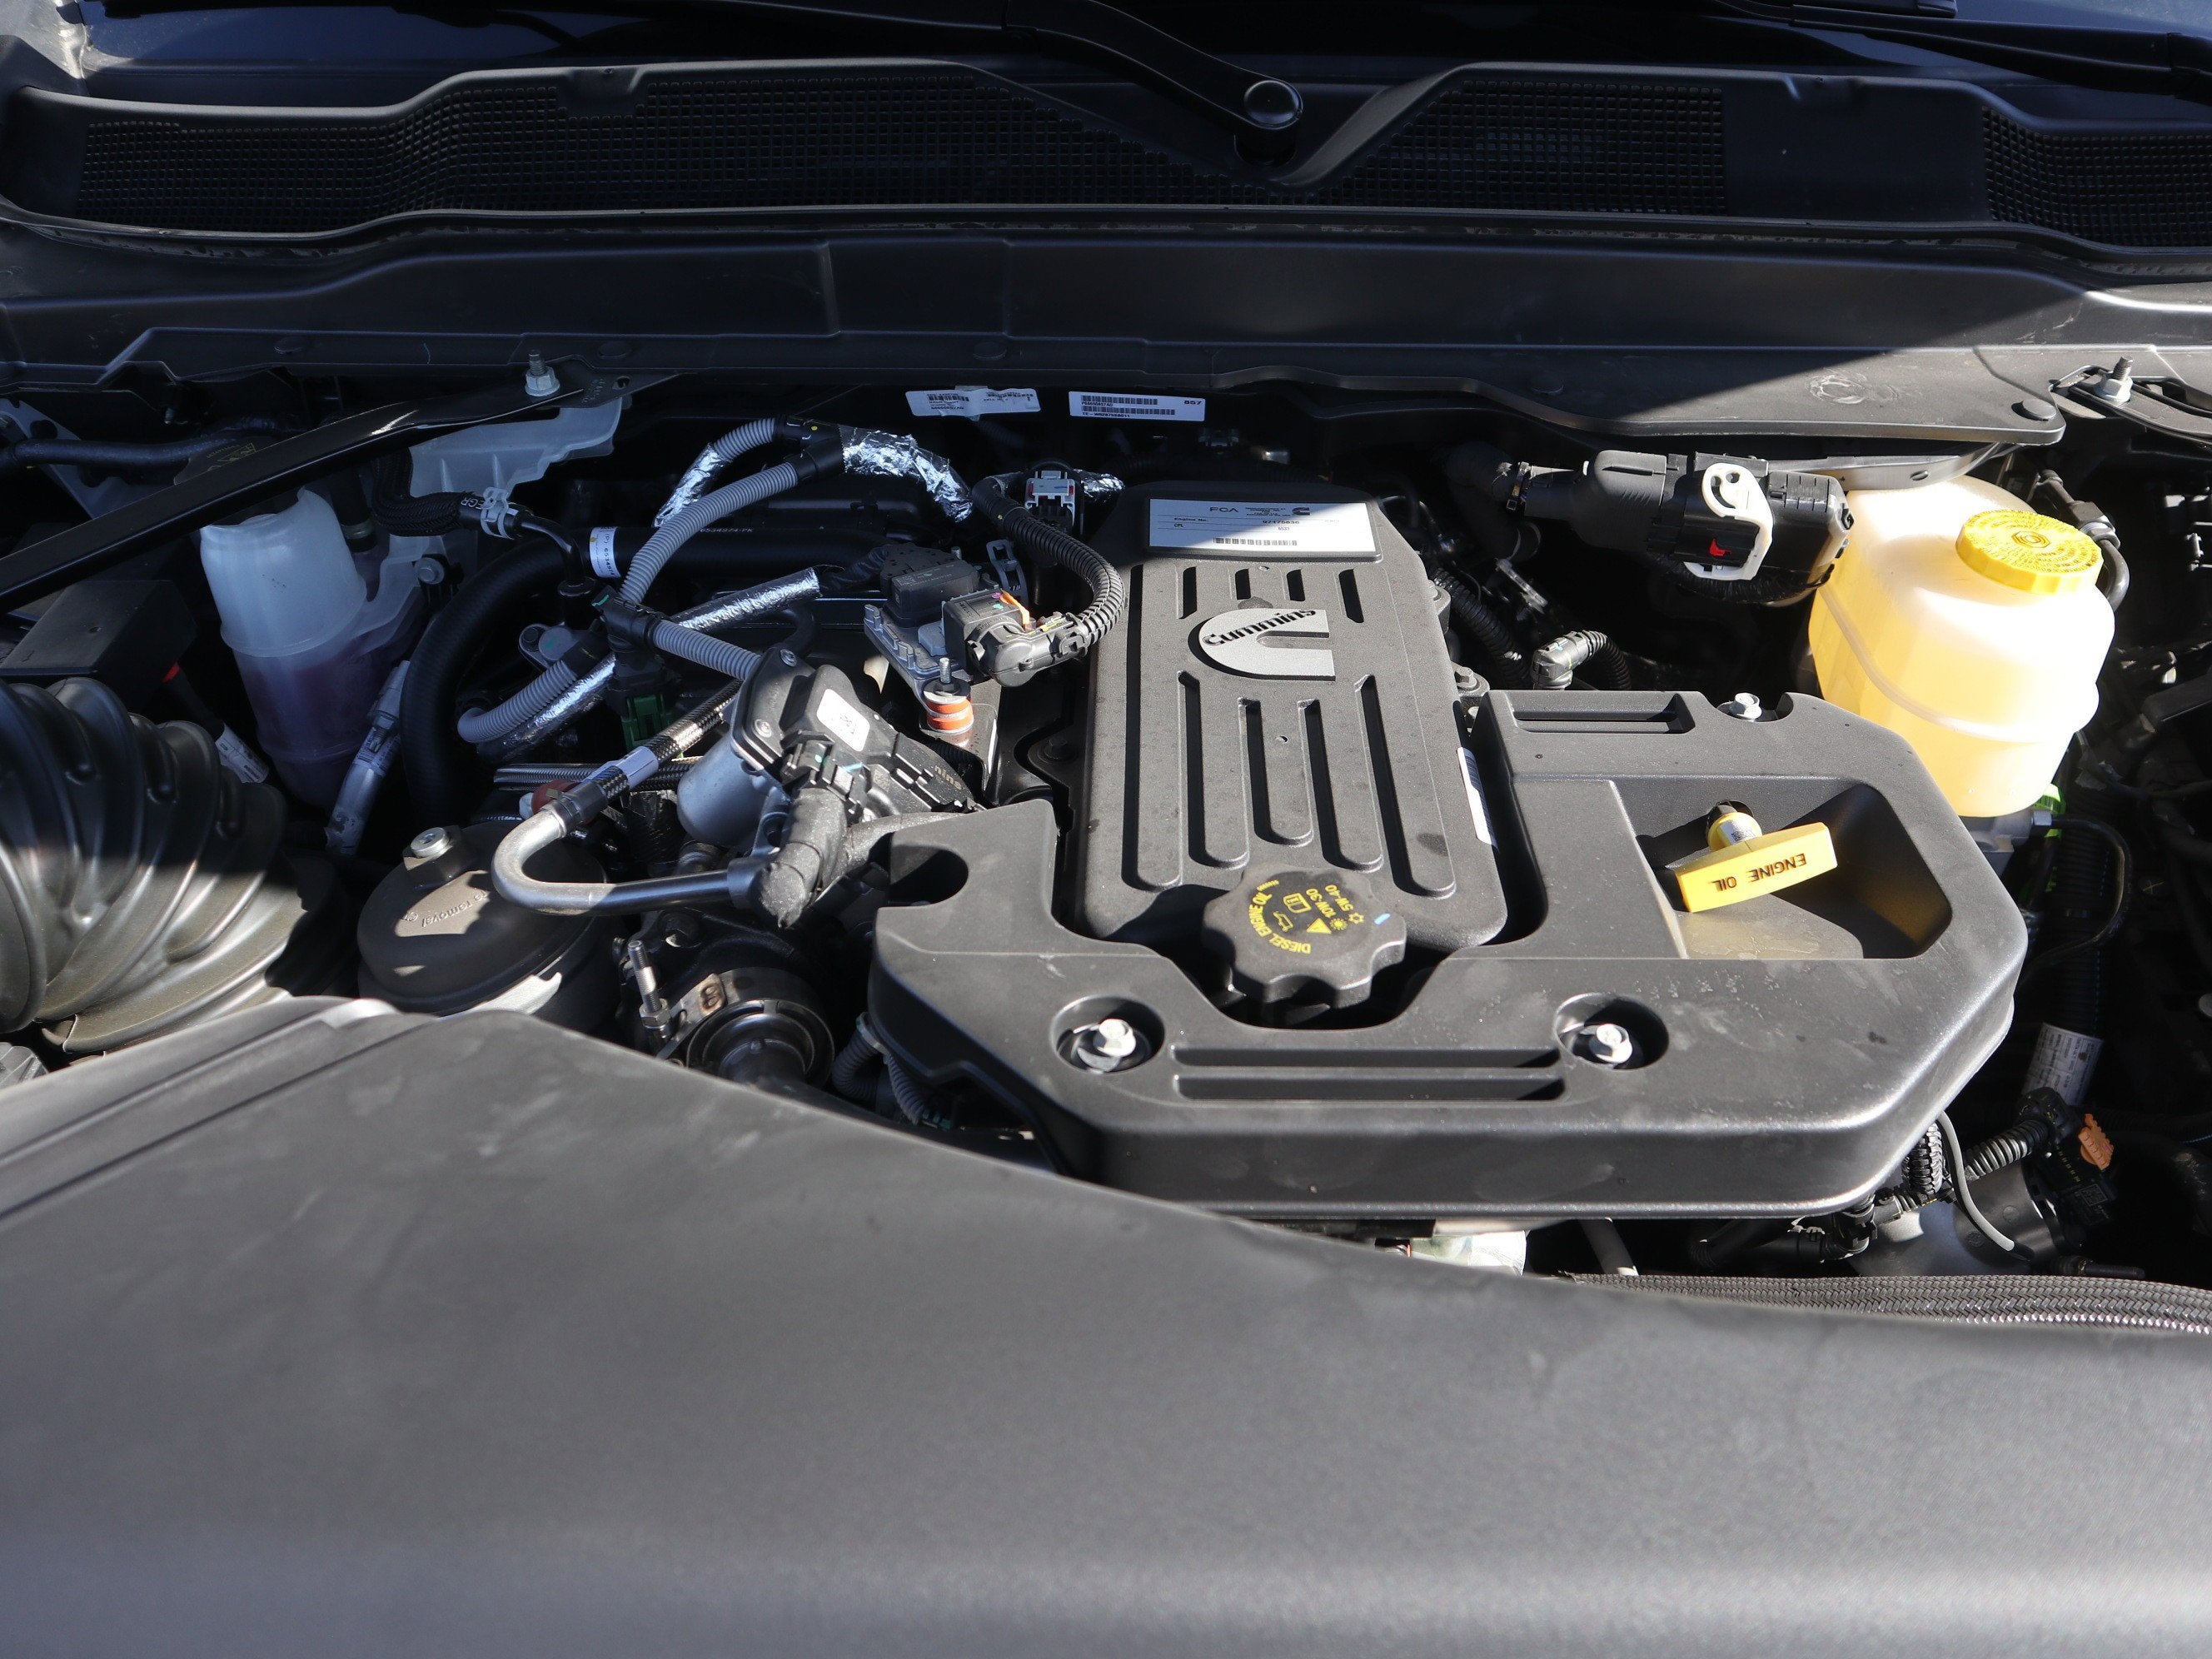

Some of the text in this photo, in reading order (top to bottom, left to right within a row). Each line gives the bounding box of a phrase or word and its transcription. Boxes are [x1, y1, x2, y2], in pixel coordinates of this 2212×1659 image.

[1203, 609, 1317, 646] Cummins
[1711, 853, 1807, 893] ENGINE OIL
[1252, 891, 1273, 905] OIL
[1324, 884, 1353, 912] 5W-40
[421, 900, 473, 928] removal
[1248, 904, 1273, 938] ENGINE
[1268, 932, 1312, 954] DIESEL
